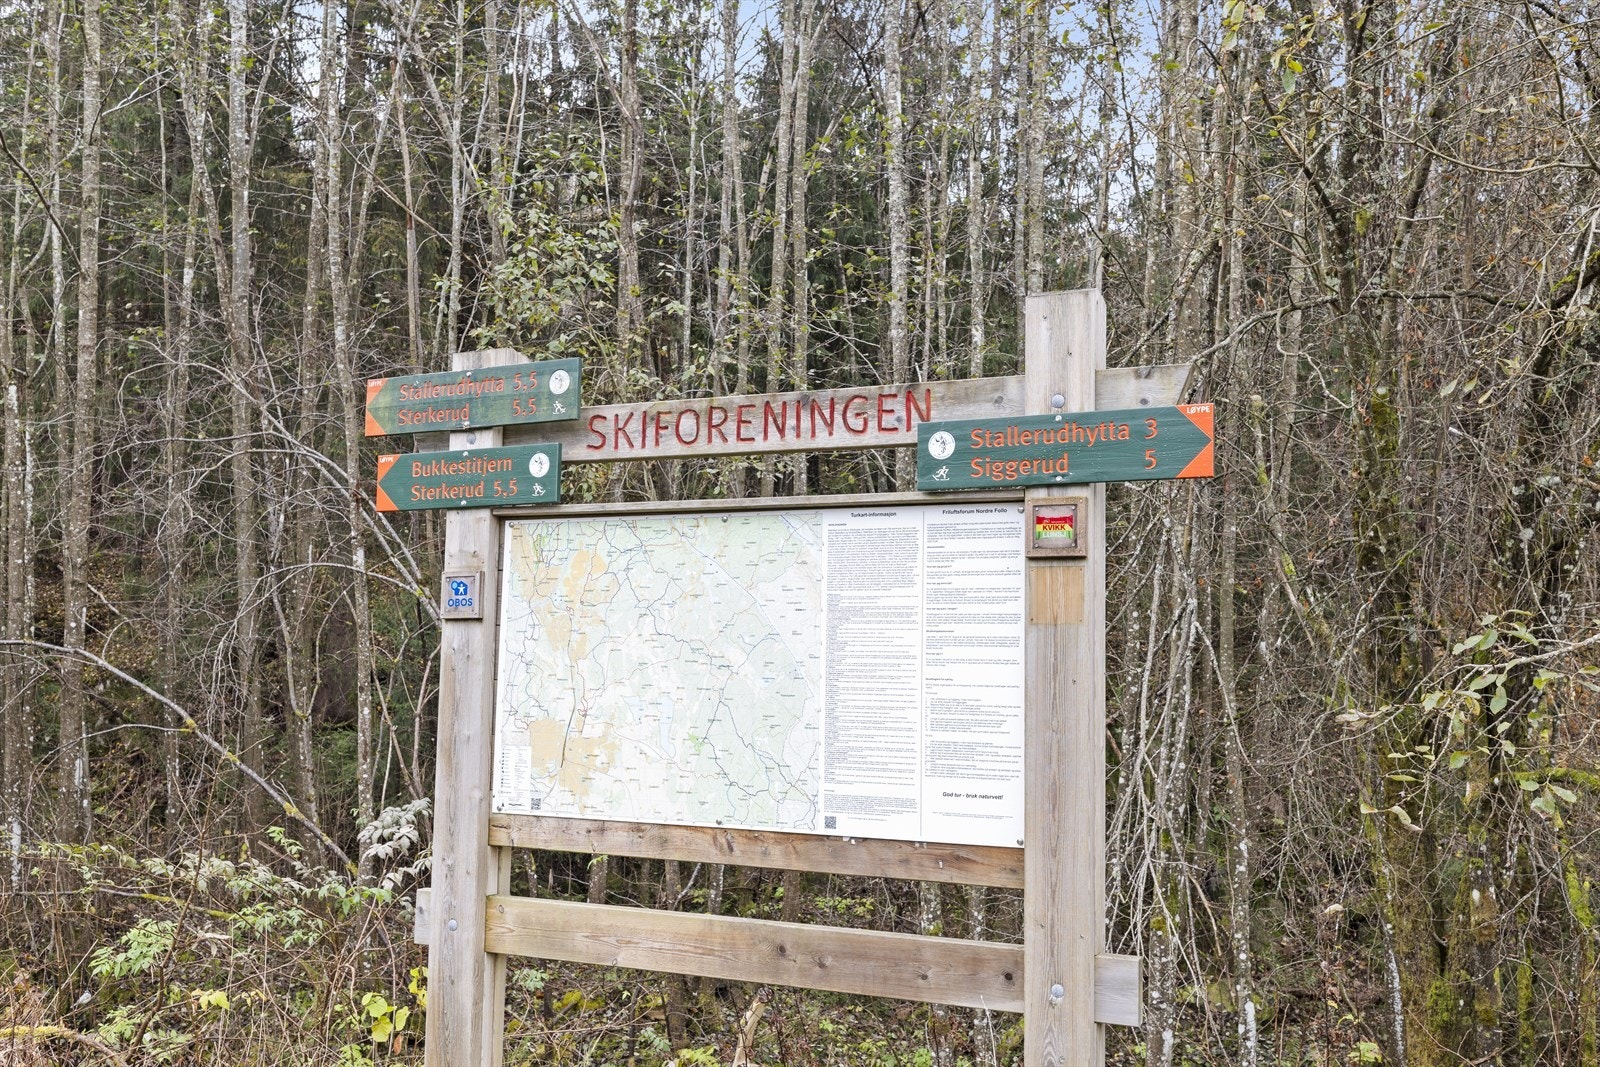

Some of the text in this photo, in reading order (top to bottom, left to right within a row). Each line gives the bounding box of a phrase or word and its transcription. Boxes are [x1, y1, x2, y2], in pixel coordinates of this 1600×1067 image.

[399, 371, 538, 402] Stallerudhytta 5,5
[398, 397, 537, 426] Sterkerud 5,5
[586, 388, 932, 450] SKIFORENINGEN
[1186, 406, 1211, 415] LØYPE
[970, 417, 1159, 448] Stallerudhytta 3
[411, 457, 513, 478] Bukkestitjern
[970, 449, 1159, 481] Siggerud 5
[411, 479, 519, 501] Sterkerud 5,5
[851, 511, 897, 519] Turkart-informasjon
[447, 598, 473, 608] OBOS
